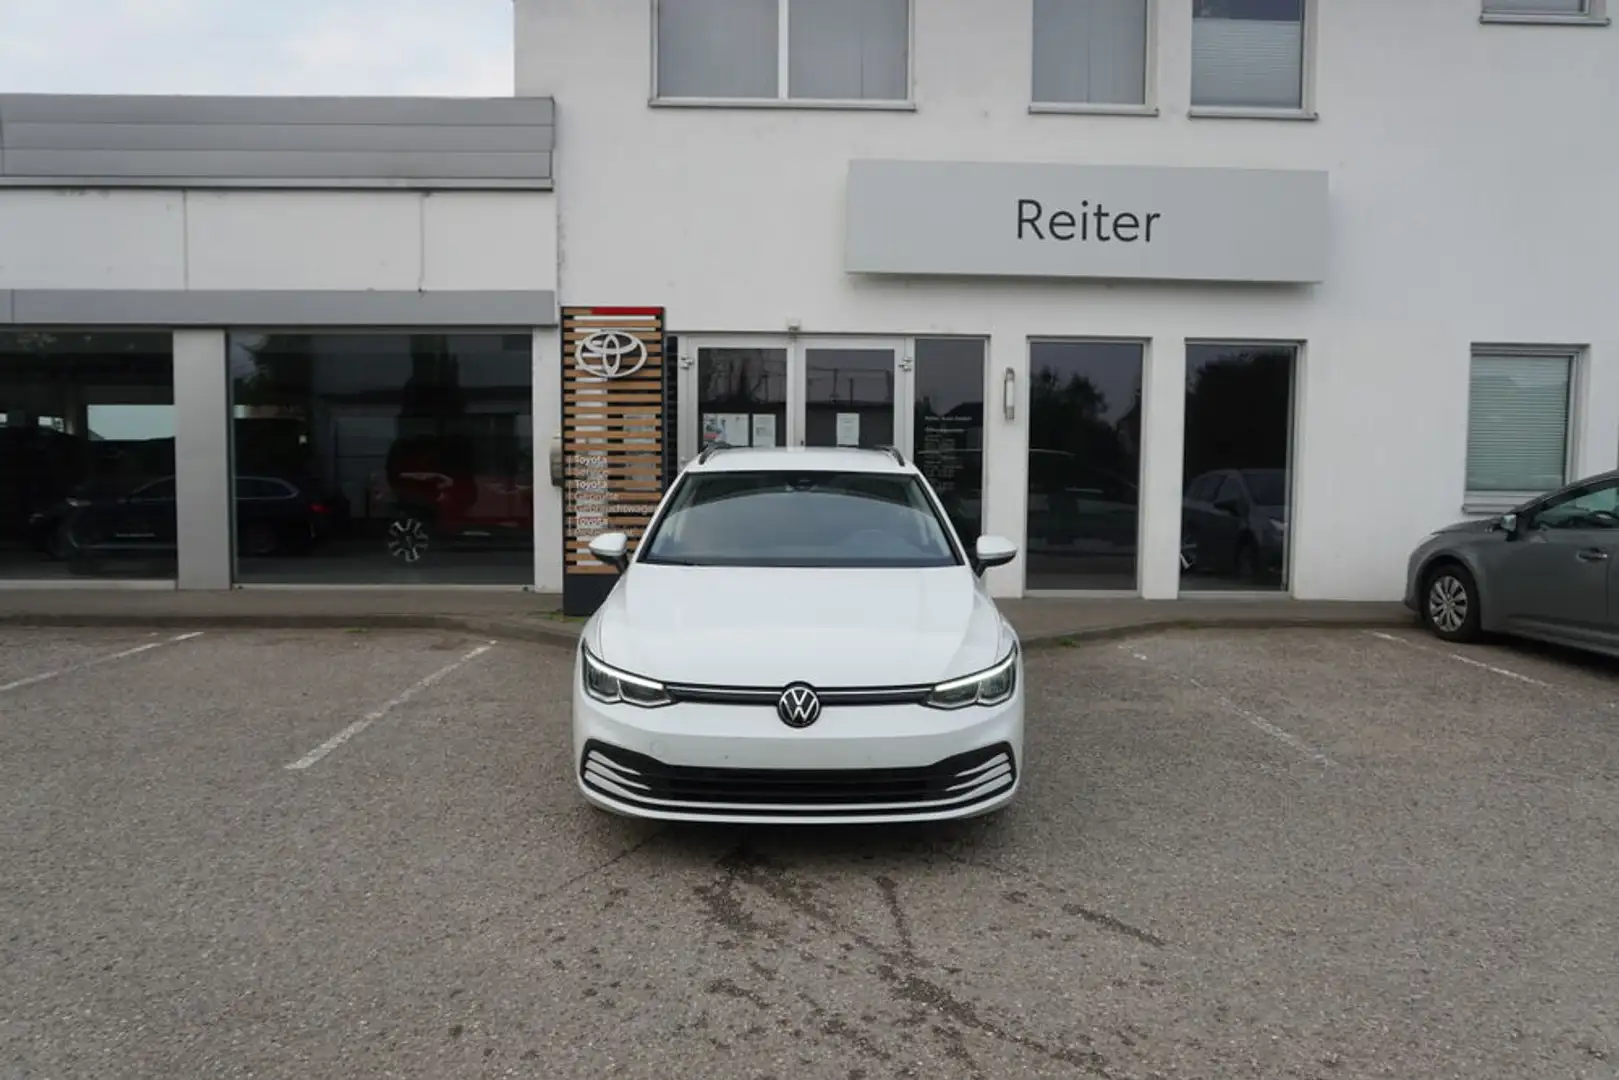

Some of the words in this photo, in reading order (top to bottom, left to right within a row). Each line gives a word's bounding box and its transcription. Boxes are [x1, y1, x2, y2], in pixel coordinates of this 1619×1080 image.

[1017, 199, 1161, 242] Reiter
[575, 455, 608, 465] Toyota
[576, 479, 608, 489] Toyota
